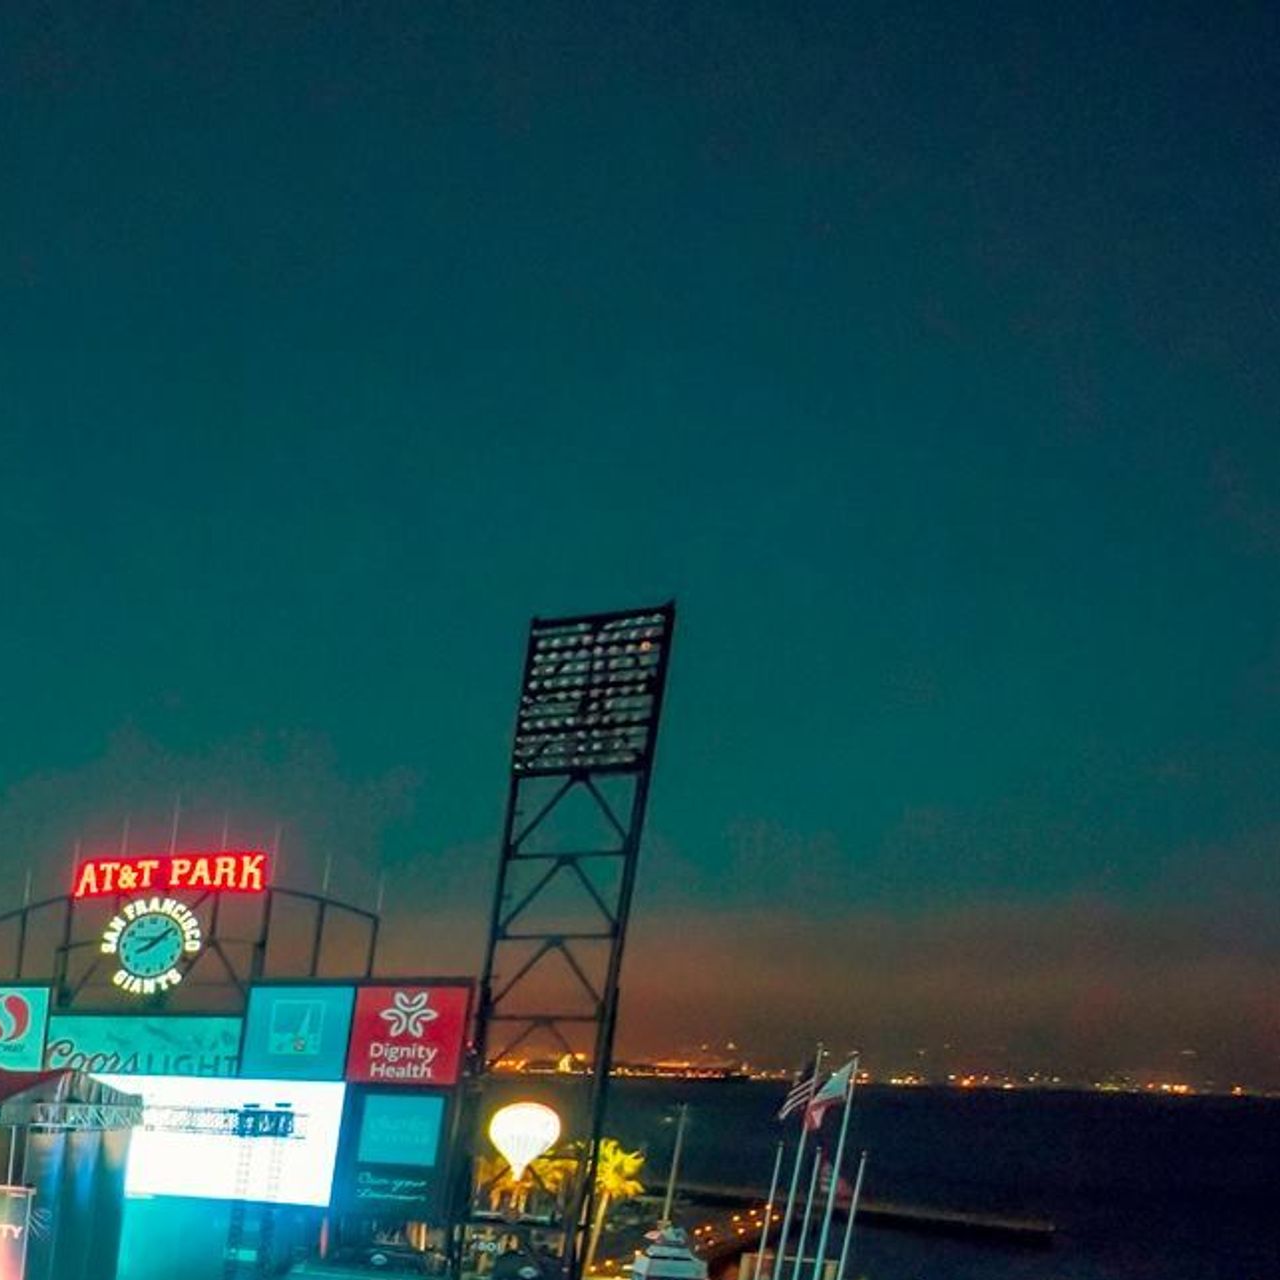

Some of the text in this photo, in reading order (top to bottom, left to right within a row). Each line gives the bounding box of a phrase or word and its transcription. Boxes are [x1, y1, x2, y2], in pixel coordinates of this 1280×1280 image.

[75, 854, 264, 897] AT&T PARK
[101, 896, 202, 954] SAN FRANCISCO
[112, 967, 183, 994] GIANTS
[45, 1038, 141, 1074] Coors
[368, 1042, 438, 1064] Dignity
[369, 1062, 433, 1079] Health
